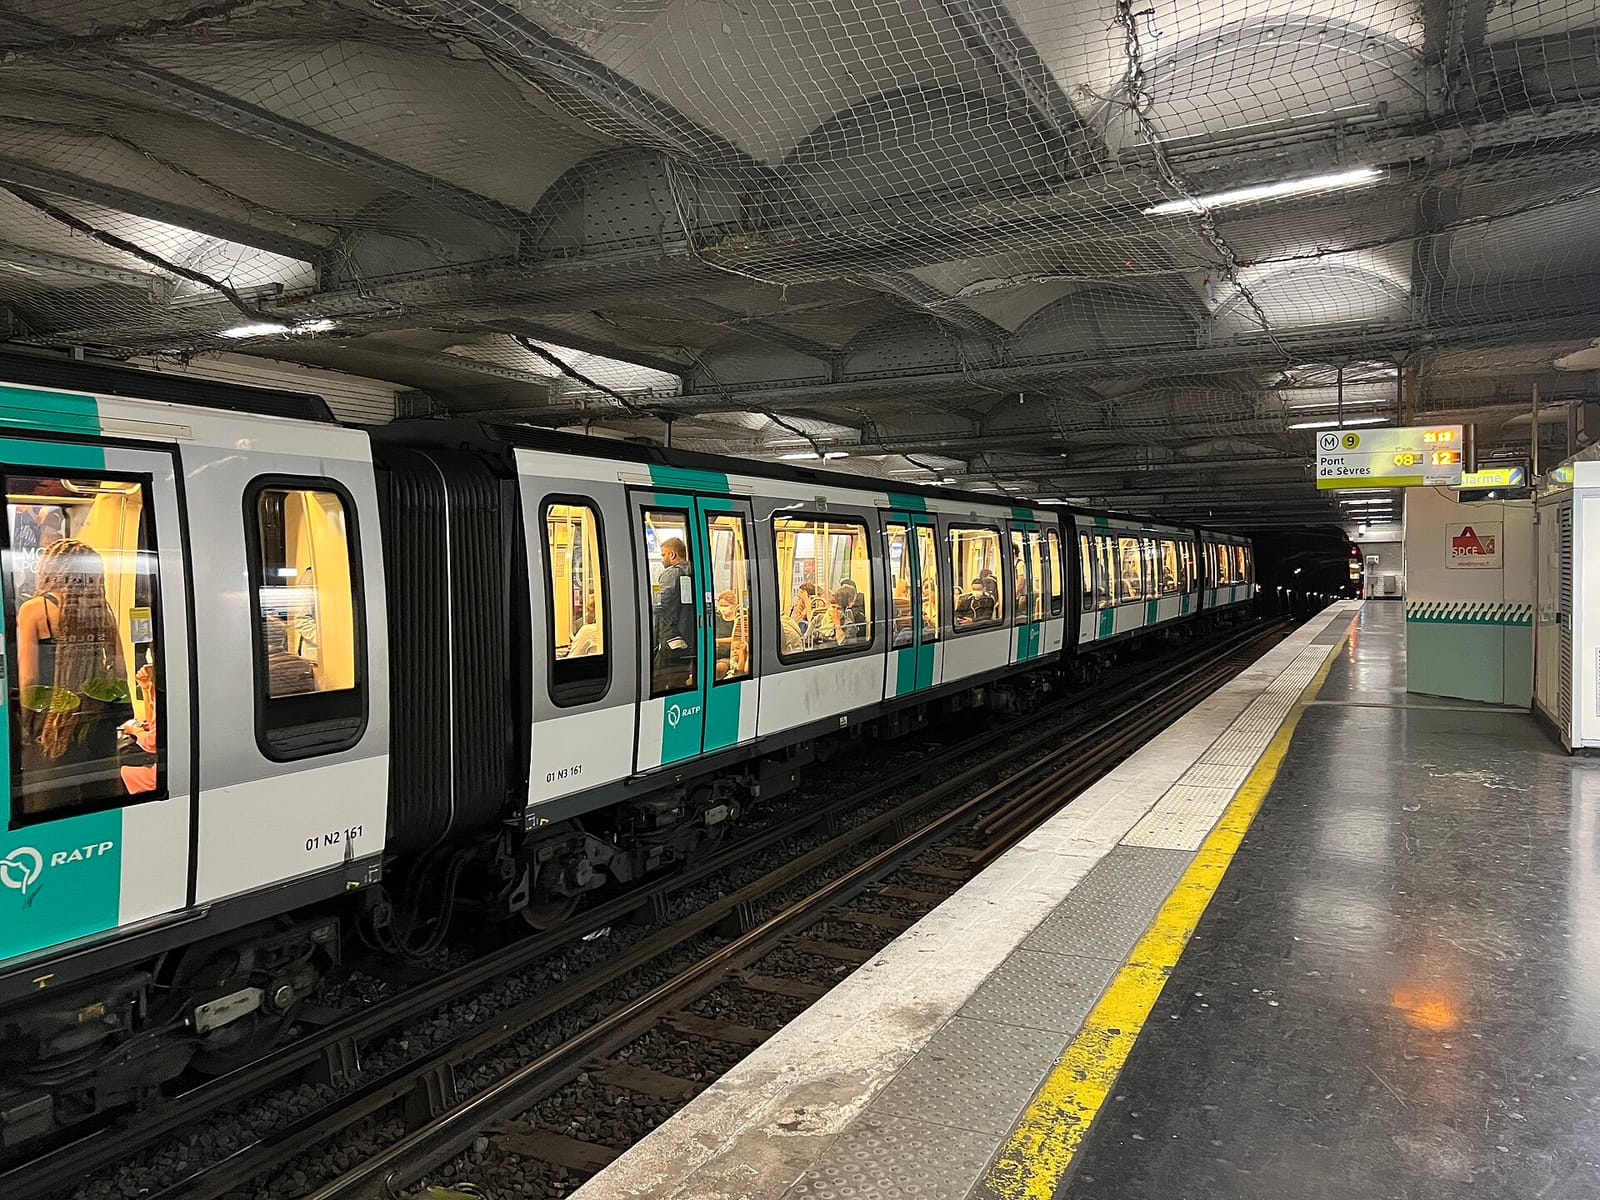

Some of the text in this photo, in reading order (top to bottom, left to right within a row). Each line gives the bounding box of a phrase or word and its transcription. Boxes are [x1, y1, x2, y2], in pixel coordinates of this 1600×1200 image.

[1346, 436, 1355, 447] 9
[1320, 457, 1345, 466] Pont
[1432, 451, 1451, 465] 12
[1320, 466, 1371, 476] de Sèvres
[1462, 475, 1502, 485] larme
[681, 706, 701, 717] RATP
[546, 765, 582, 783] 01 N3 161
[305, 826, 364, 852] 01 N2 161
[50, 840, 114, 867] RATP
